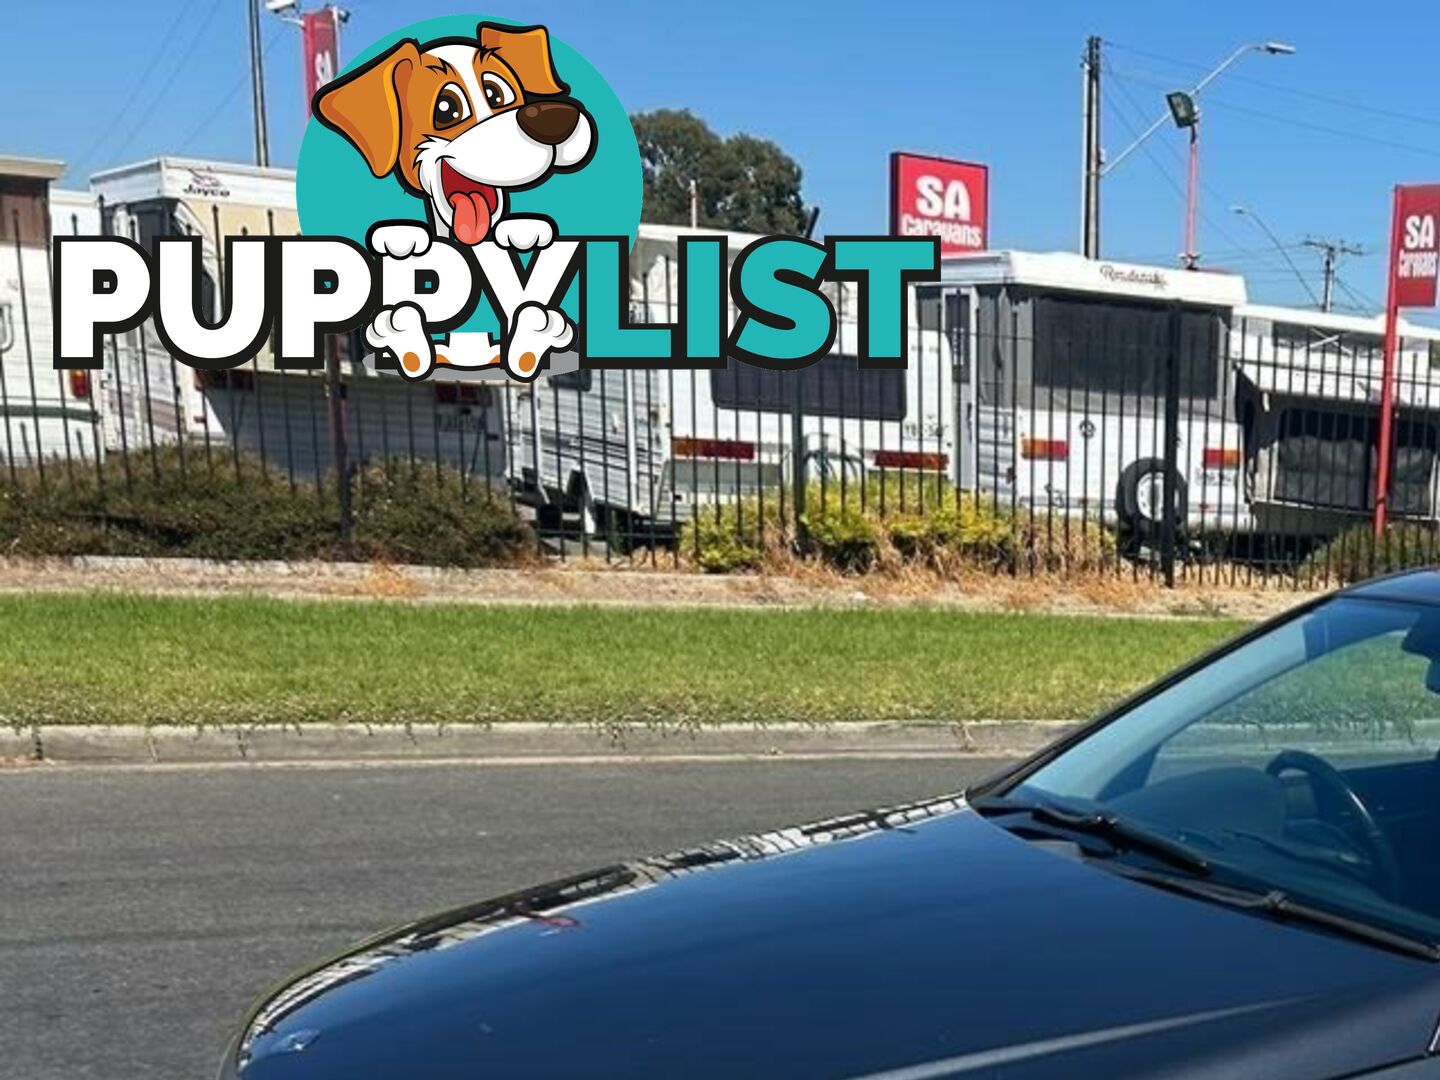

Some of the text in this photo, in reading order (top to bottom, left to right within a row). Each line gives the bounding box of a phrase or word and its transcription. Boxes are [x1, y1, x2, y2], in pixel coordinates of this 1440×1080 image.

[183, 184, 230, 197] Jayco
[915, 174, 971, 220] SA
[901, 212, 983, 249] Caravans
[1405, 214, 1435, 249] SA
